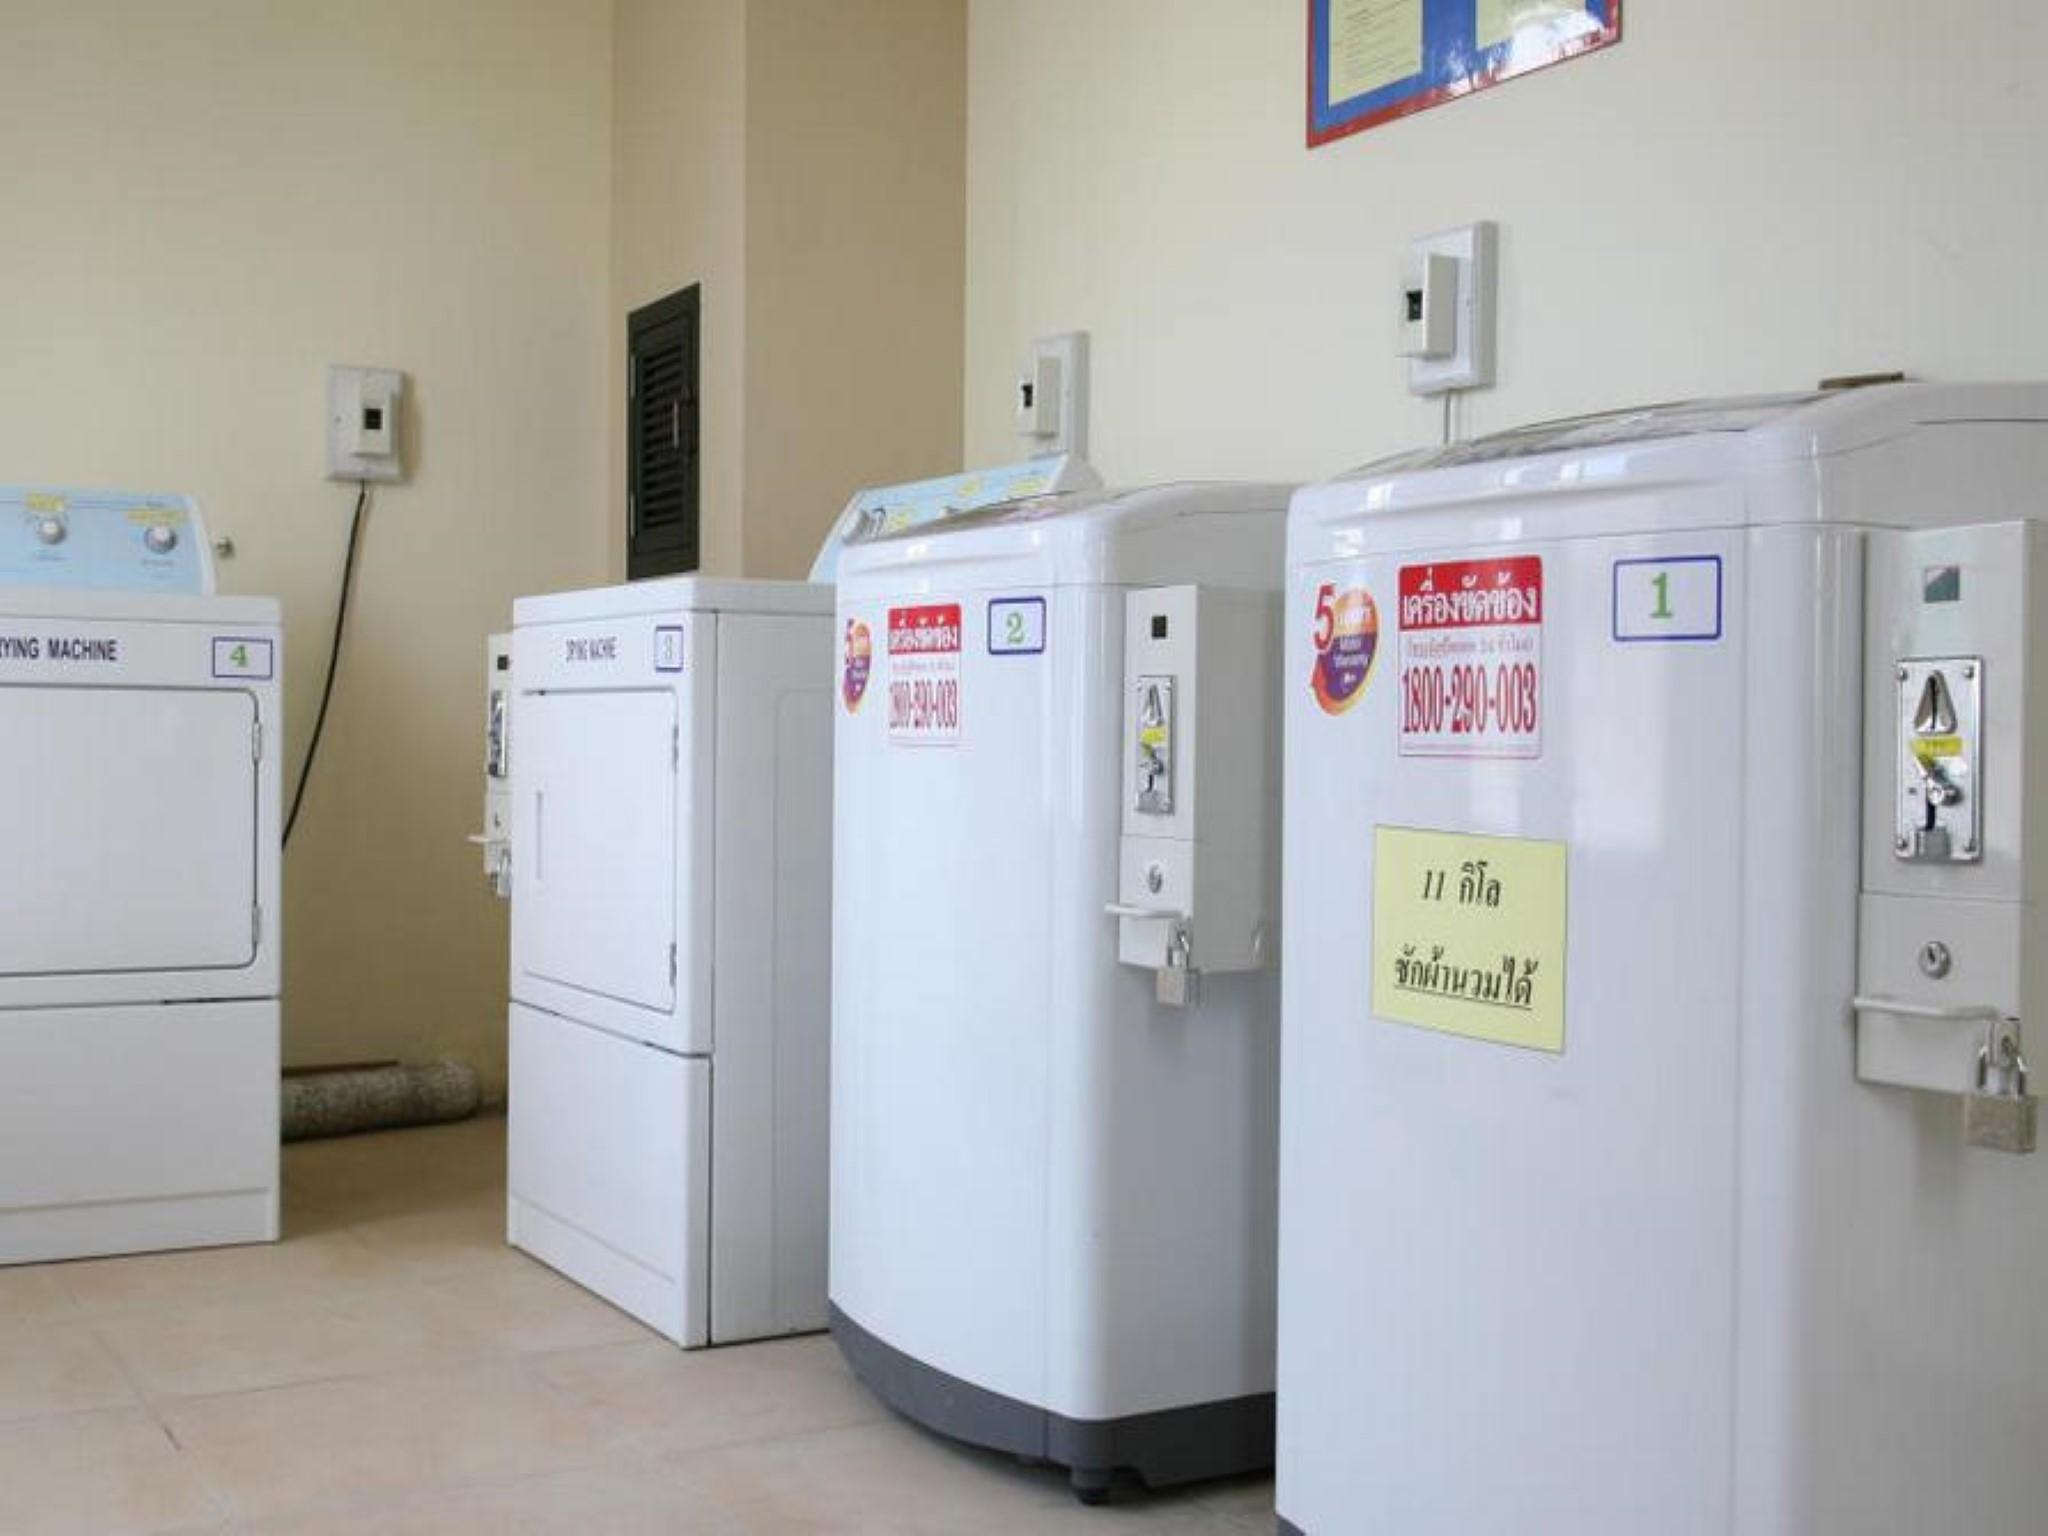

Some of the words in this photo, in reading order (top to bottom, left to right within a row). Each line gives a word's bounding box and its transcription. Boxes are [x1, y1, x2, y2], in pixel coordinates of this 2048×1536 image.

[1314, 583, 1335, 651] 5
[1403, 567, 1537, 625] เครื่องขัดข้อง
[1650, 572, 1673, 619] 1
[0, 636, 40, 660] YING
[47, 637, 118, 661] MACHINE
[1006, 611, 1025, 643] 2
[229, 644, 248, 668] 4
[1403, 662, 1537, 733] 1800-290-003
[1422, 869, 1446, 901] 11
[1458, 861, 1502, 907] กิโล
[1394, 943, 1539, 1005] ซักผ้านวมได้
